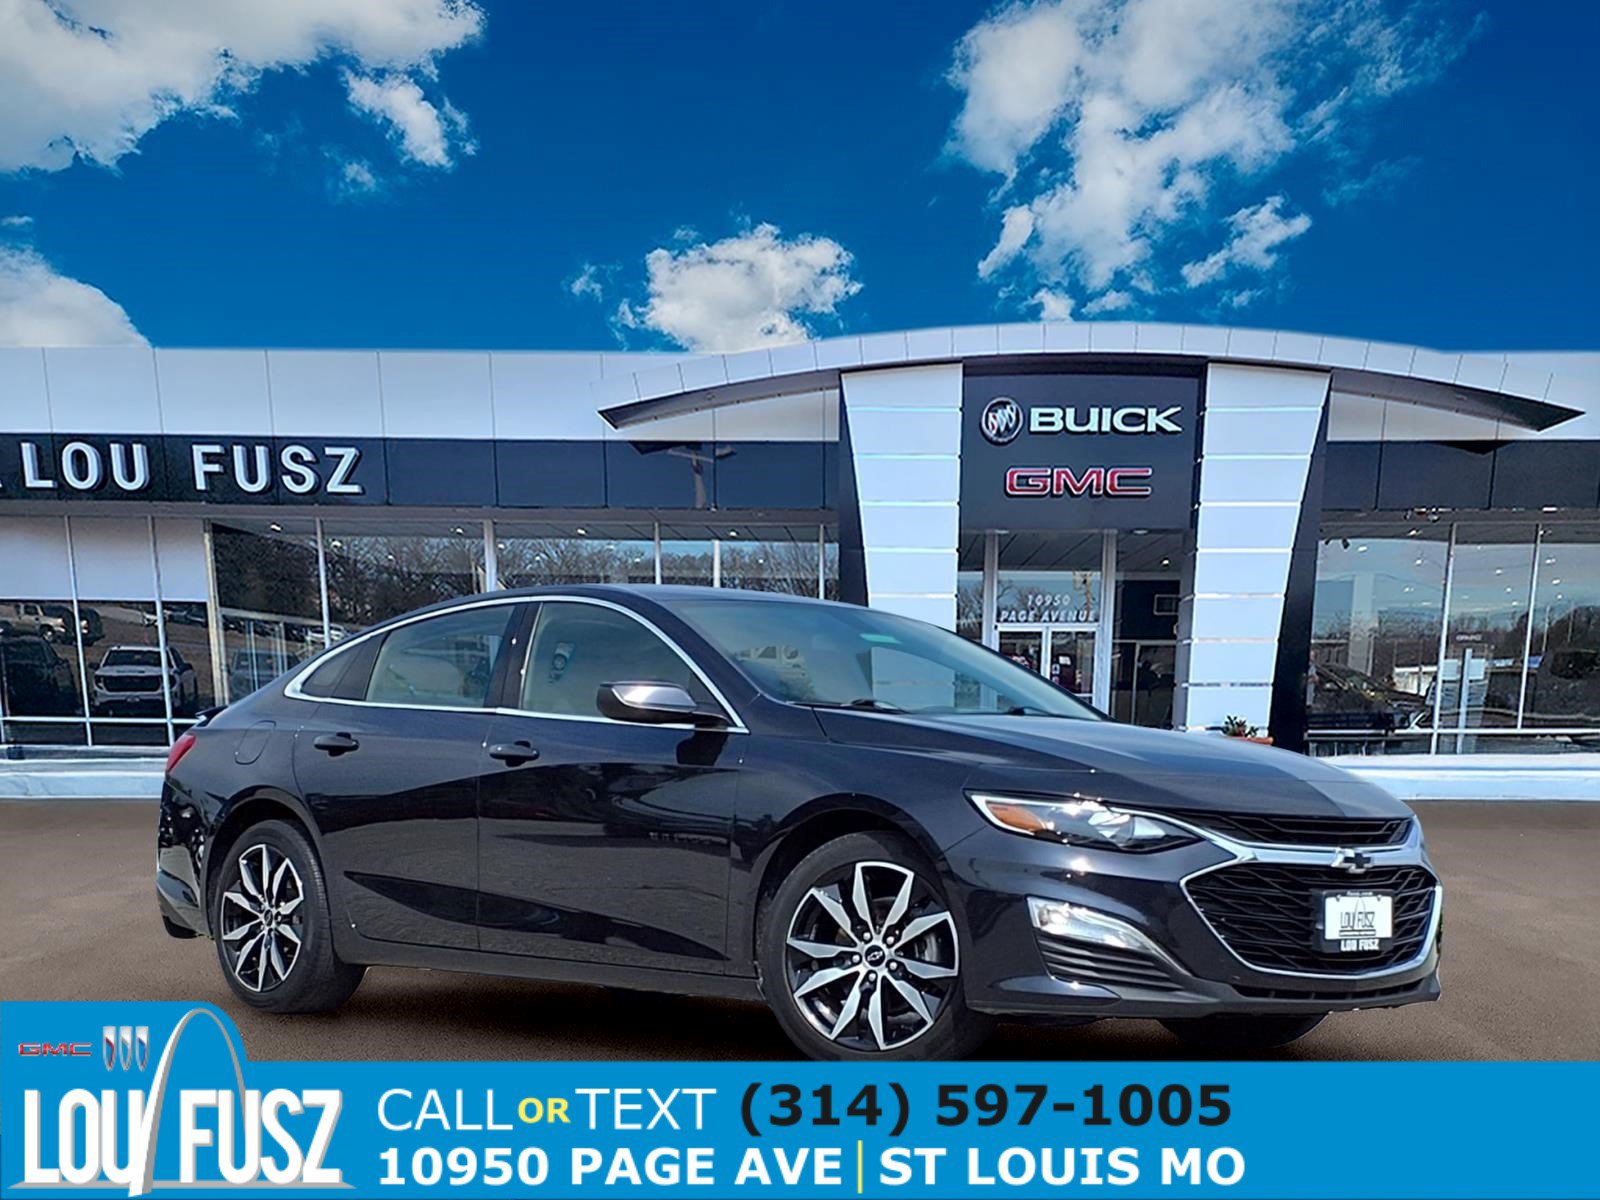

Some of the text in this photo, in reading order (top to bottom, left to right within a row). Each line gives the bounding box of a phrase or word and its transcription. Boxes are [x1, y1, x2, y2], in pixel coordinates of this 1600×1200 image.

[1029, 406, 1182, 433] BUICK
[20, 441, 363, 494] LOU FUSZ
[1006, 467, 1152, 495] GMC
[1027, 594, 1071, 606] 10950
[1000, 610, 1096, 622] PAGE AVENUE
[1340, 911, 1356, 929] LOU
[1340, 938, 1379, 952] LOU FUSZ
